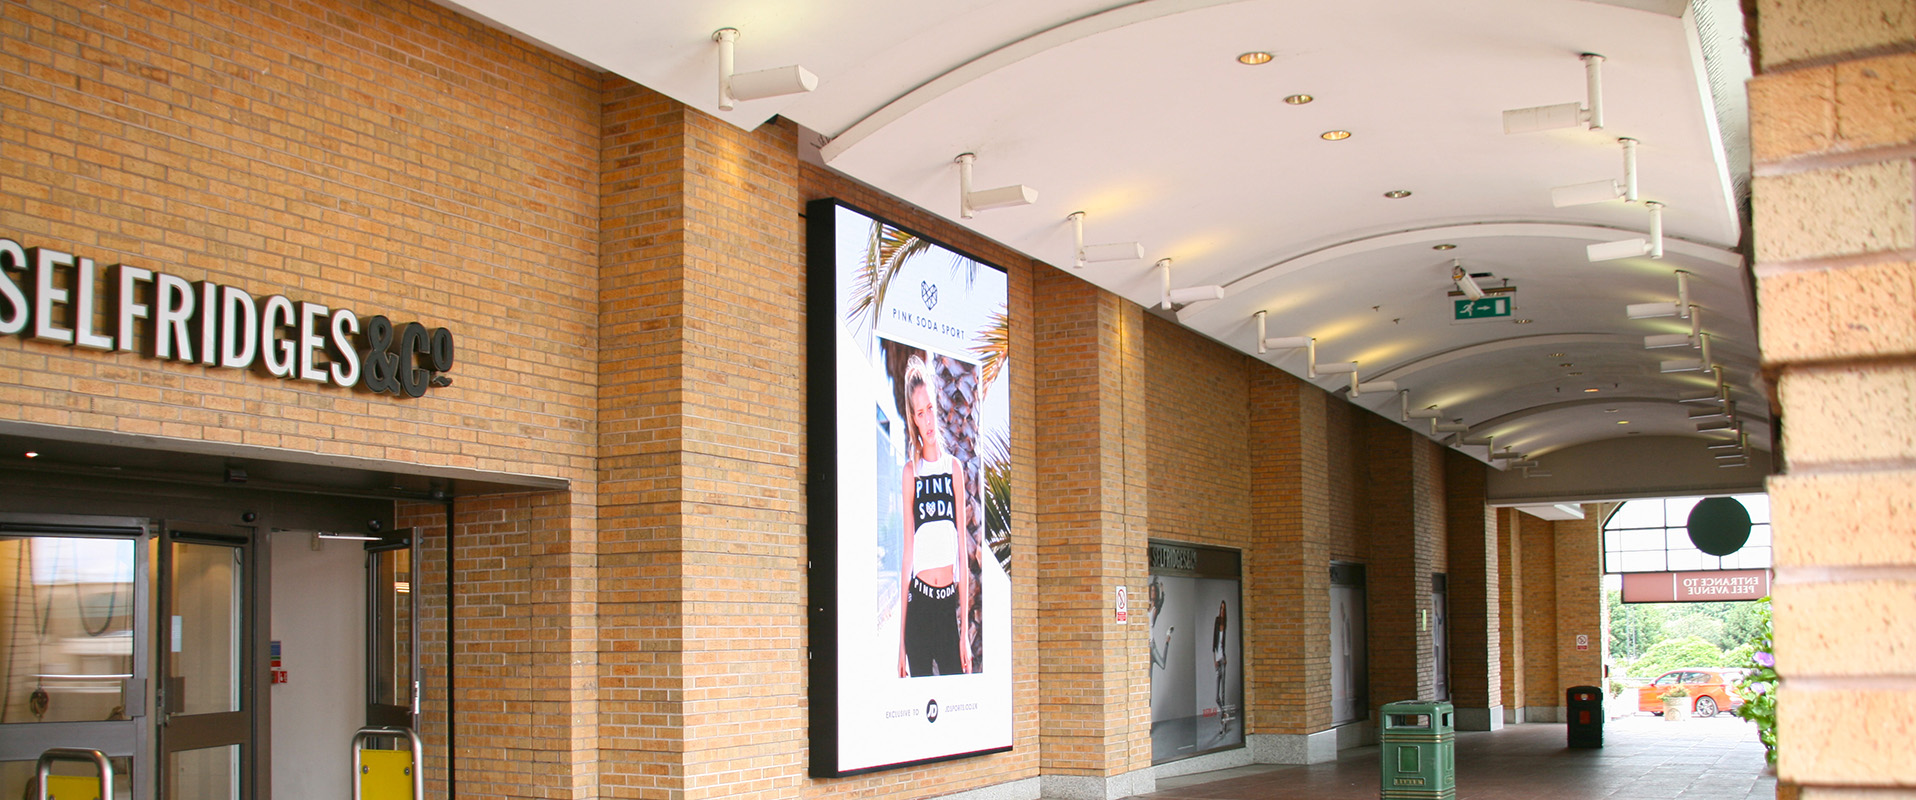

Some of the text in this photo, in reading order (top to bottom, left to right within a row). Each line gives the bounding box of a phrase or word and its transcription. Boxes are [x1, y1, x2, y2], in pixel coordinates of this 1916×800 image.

[892, 308, 965, 340] PINK SODA SPORT
[916, 476, 953, 498] PINK
[914, 578, 955, 600] PINK SODA
